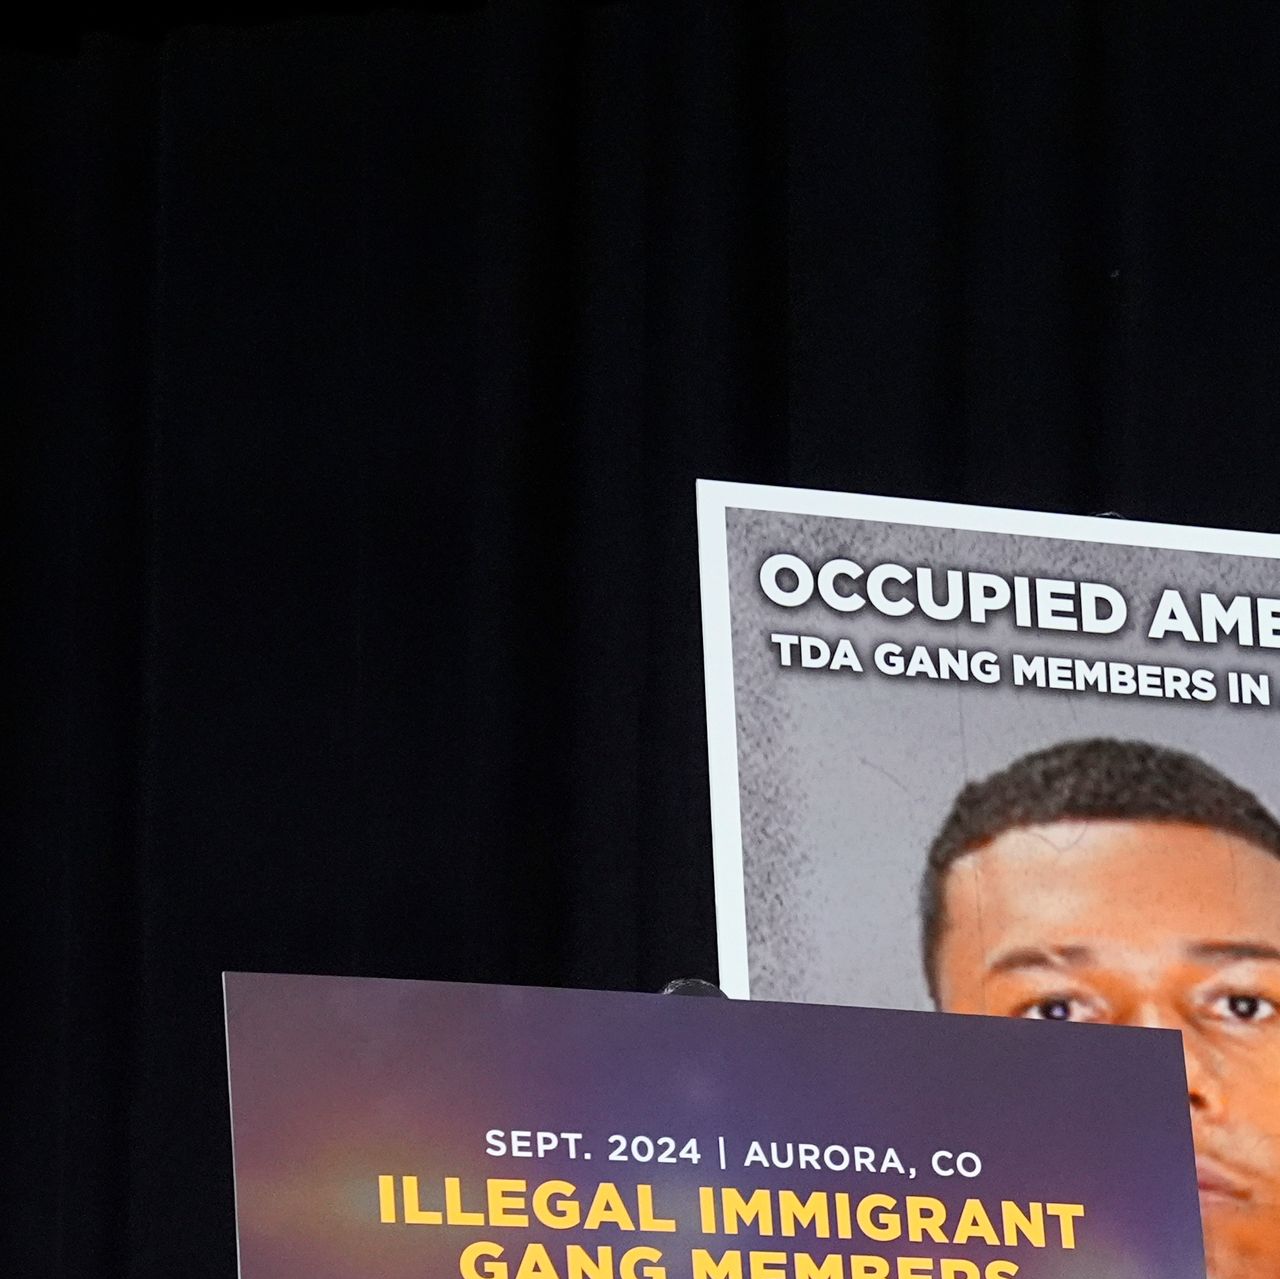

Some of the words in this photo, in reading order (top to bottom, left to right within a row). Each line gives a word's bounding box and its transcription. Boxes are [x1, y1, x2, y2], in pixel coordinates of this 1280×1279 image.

[759, 553, 1127, 636] OCCUPIED
[771, 633, 864, 672] TDA
[874, 642, 1001, 684] GANG
[1012, 654, 1217, 701] MEMBERS
[1228, 672, 1270, 706] IN
[485, 1129, 591, 1160] SEPT.
[608, 1134, 701, 1164] 2024
[743, 1141, 916, 1179] AURORA,
[931, 1150, 982, 1178] CO
[378, 1174, 677, 1233] ILLEGAL
[699, 1186, 1085, 1249] IMMIGRANT
